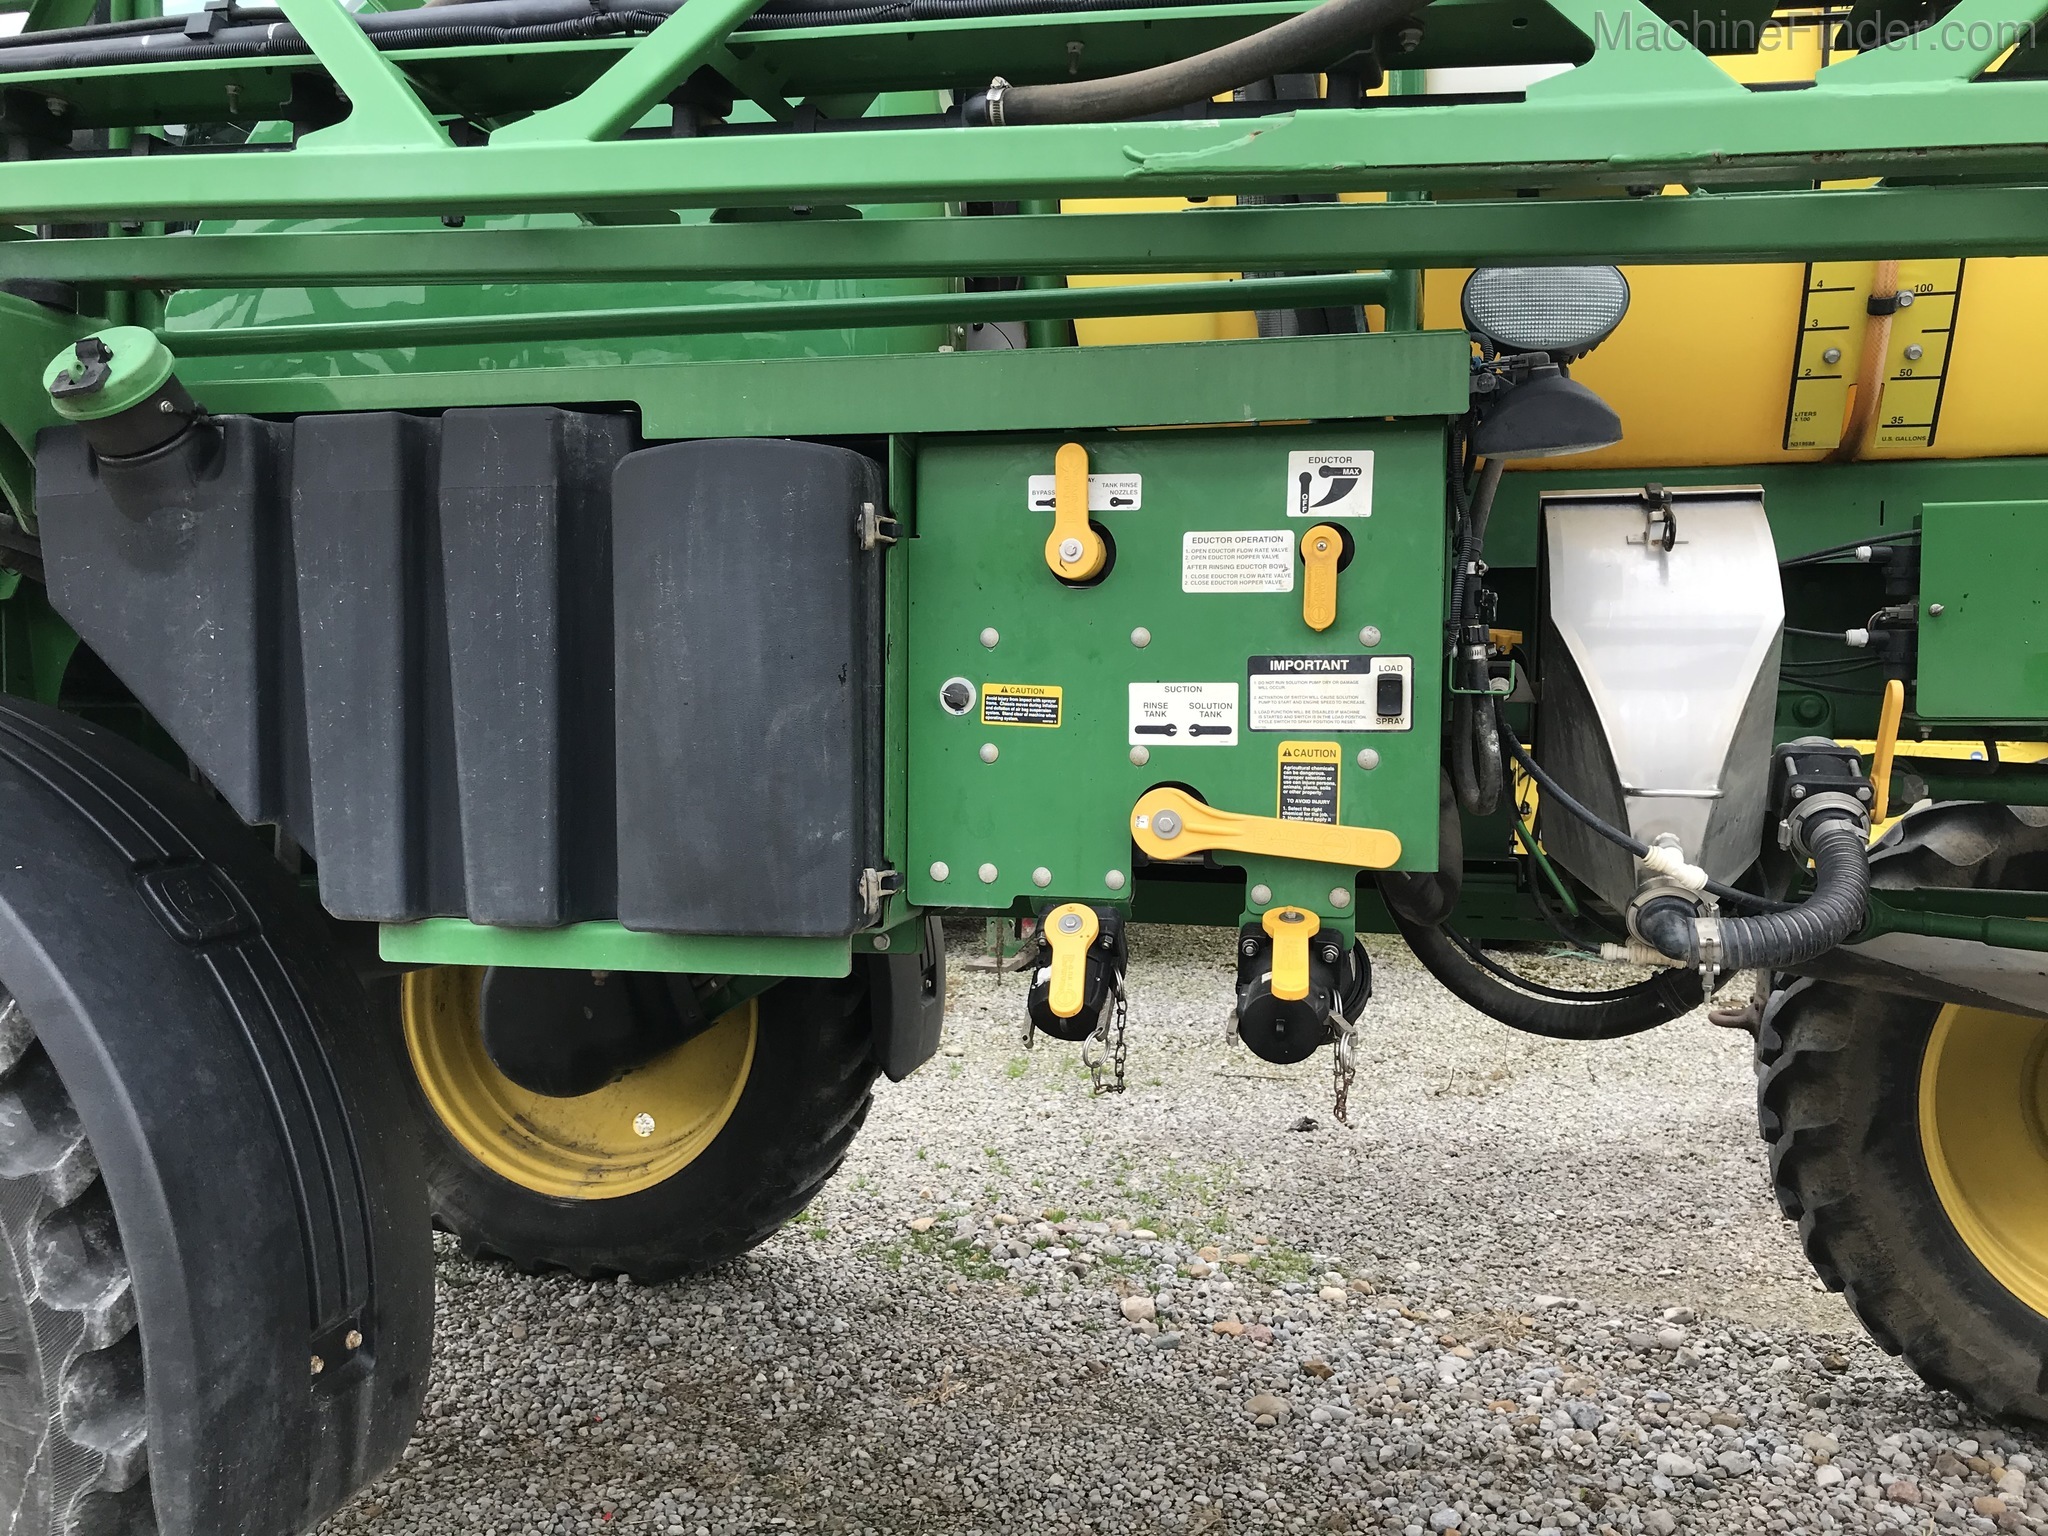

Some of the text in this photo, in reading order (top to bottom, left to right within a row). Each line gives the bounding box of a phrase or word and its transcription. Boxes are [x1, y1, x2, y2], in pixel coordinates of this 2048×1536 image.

[1915, 284, 1933, 292] 100
[1812, 319, 1818, 327] 3
[1900, 369, 1912, 377] 50
[1270, 660, 1349, 670] IMPORTANT
[1294, 749, 1336, 757] CAUTION
